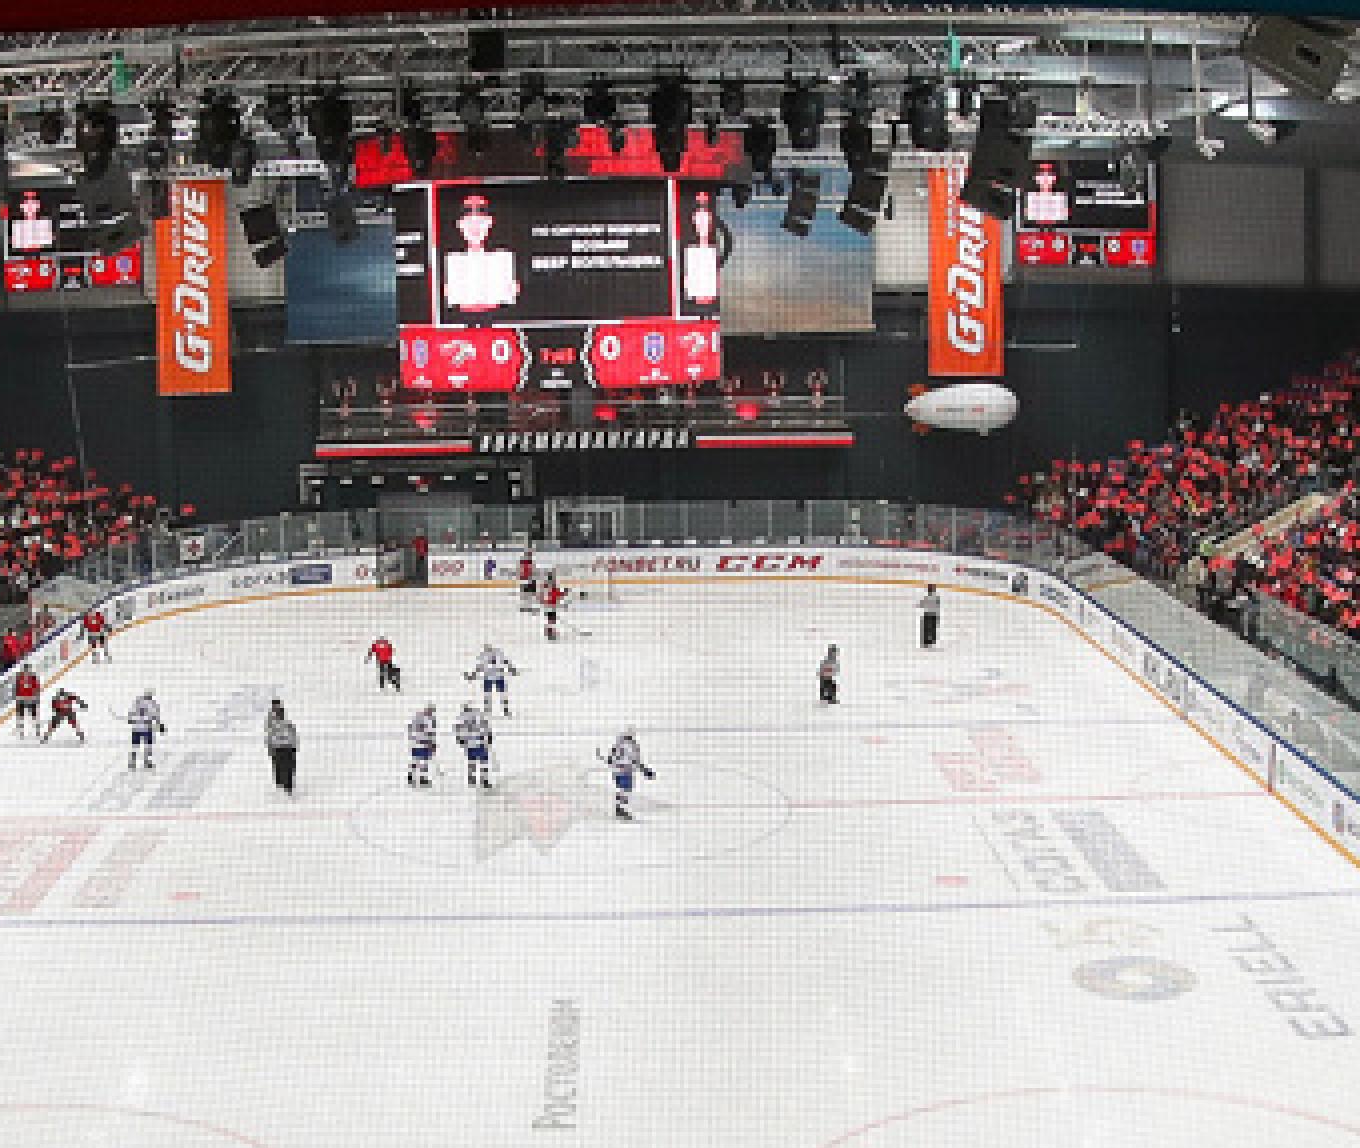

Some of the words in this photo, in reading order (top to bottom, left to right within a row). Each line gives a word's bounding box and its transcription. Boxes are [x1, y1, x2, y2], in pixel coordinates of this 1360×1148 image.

[491, 339, 512, 362] 0
[599, 335, 622, 361] 0
[715, 555, 825, 573] CCM
